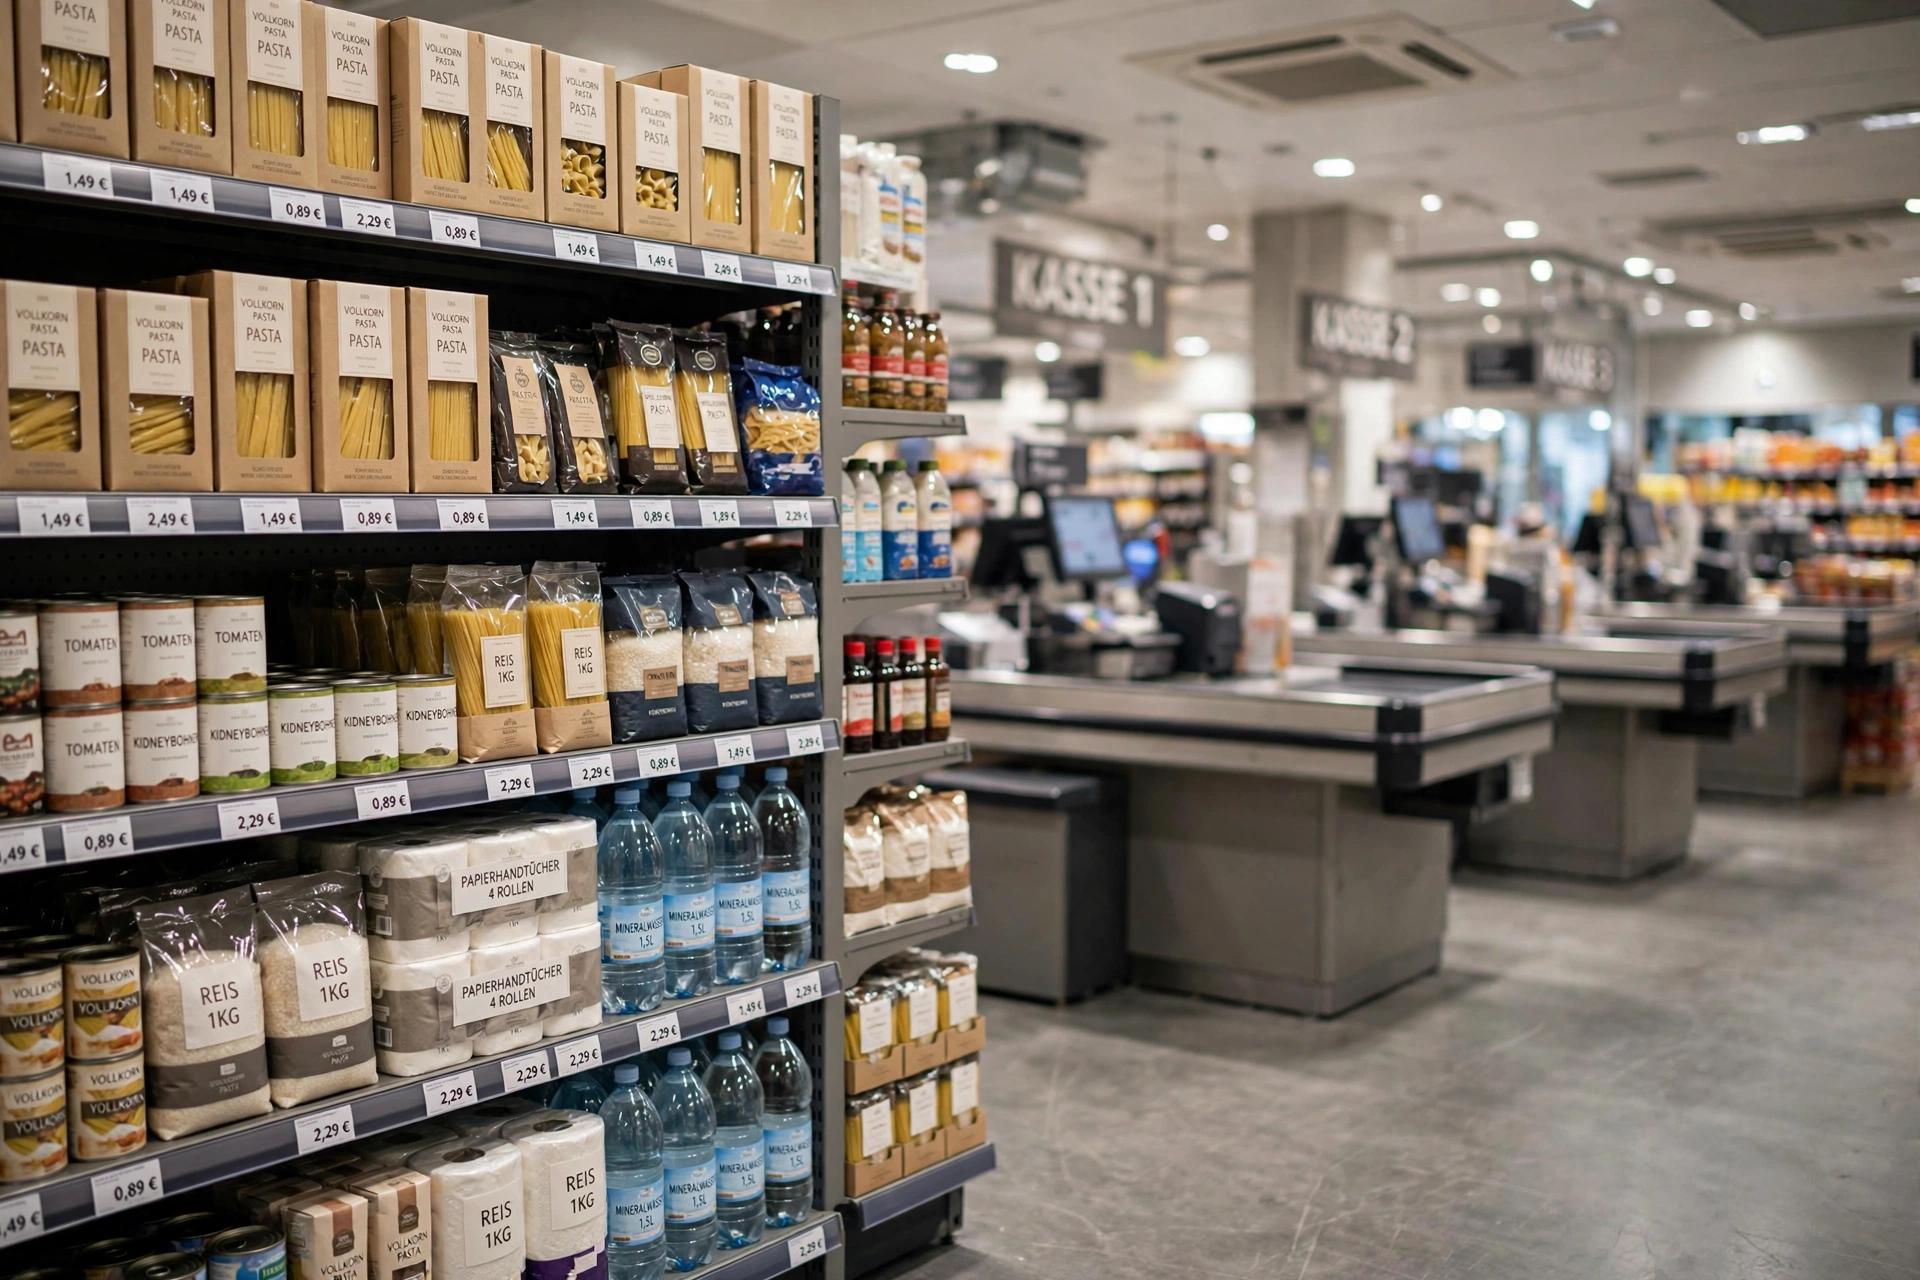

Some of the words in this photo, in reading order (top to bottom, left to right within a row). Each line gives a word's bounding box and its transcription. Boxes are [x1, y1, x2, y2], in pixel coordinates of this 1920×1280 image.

[54, 1, 96, 23] PASTA
[172, 8, 196, 22] PASTA
[252, 11, 294, 28] VOLLKORN
[165, 24, 202, 44] PASTA
[264, 25, 286, 38] PASTA
[331, 31, 370, 46] VOLLKORN
[258, 40, 291, 59] PASTA
[342, 43, 363, 56] PASTA
[425, 42, 462, 59] VOLLKORN
[337, 57, 368, 75] PASTA
[435, 56, 455, 67] PASTA
[430, 70, 460, 86] PASTA
[501, 69, 519, 80] PASTA
[496, 83, 523, 100] PASTA
[569, 102, 597, 119] PASTA
[644, 130, 669, 146] PASTA
[66, 172, 95, 189] 1,49
[99, 177, 108, 190] €
[170, 187, 199, 203] 1,49
[200, 192, 209, 204] €
[286, 203, 310, 218] 0,89
[312, 208, 321, 219] €
[357, 213, 382, 228] 2,29
[383, 218, 391, 229] €
[445, 225, 467, 240] 0,89
[469, 229, 476, 241] €
[568, 244, 588, 256] 1,49
[589, 245, 595, 257] €
[648, 254, 665, 267] 1,49
[667, 257, 674, 268] €
[731, 265, 738, 277] €
[1012, 250, 1126, 321] KASSE
[1134, 274, 1153, 327] 1
[241, 298, 284, 310] VOLLKORN
[344, 306, 384, 318] VOLLKORN
[16, 309, 68, 322] VOLLKORN
[253, 312, 276, 322] PASTA
[355, 319, 376, 328] PASTA
[432, 312, 470, 324] VOLLKORN
[30, 324, 58, 335] PASTA
[136, 318, 183, 330] VOLLKORN
[443, 325, 462, 334] PASTA
[1313, 300, 1389, 359] KASSE
[1394, 316, 1414, 363] 2
[149, 332, 174, 343] PASTA
[247, 328, 281, 343] PASTA
[350, 334, 382, 349] PASTA
[23, 340, 65, 357] PASTA
[437, 339, 467, 354] PASTA
[143, 348, 181, 364] PASTA
[41, 514, 70, 527] 1,49
[74, 514, 84, 526] €
[148, 513, 178, 527] 2,49
[180, 514, 189, 526] €
[260, 513, 285, 527] 1,49
[289, 513, 296, 525] €
[358, 512, 381, 525] 0,89
[385, 513, 392, 524] €
[453, 512, 474, 525] 0,89
[478, 513, 484, 524] €
[566, 512, 586, 524] 1,49
[588, 512, 594, 523] €
[644, 512, 663, 522] 0,89
[665, 512, 670, 521] €
[142, 634, 192, 647] TOMATEN
[216, 630, 263, 643] TOMATEN
[65, 638, 117, 652] TOMATEN
[574, 647, 593, 659] REIS
[495, 654, 514, 667] REIS
[577, 663, 593, 674] 1KG
[498, 671, 515, 683] 1KG
[66, 741, 119, 756] TOMATEN
[745, 747, 750, 756] €
[650, 759, 668, 769] 0,89
[670, 757, 676, 766] €
[583, 768, 602, 779] 2,29
[604, 767, 610, 776] €
[501, 780, 521, 792] 2,29
[523, 778, 530, 789] €
[372, 797, 396, 811] 0,89
[399, 795, 406, 806] €
[238, 815, 264, 830] 2,29
[268, 813, 275, 825] €
[85, 834, 114, 851] 0,89
[120, 833, 128, 845] €
[0, 846, 25, 863] ,49
[31, 845, 40, 857] €
[461, 859, 560, 888] PAPIERHANDTÜCHER
[489, 889, 494, 899] 4
[497, 880, 534, 898] ROLLEN
[313, 958, 347, 979] REIS
[462, 964, 562, 998] PAPIERHANDTÜCHER
[200, 981, 239, 1006] REIS
[320, 982, 349, 1003] 1KG
[490, 997, 496, 1008] 4
[498, 989, 535, 1007] ROLLEN
[208, 1007, 240, 1030] 1KG
[651, 1027, 670, 1041] 2,29
[672, 1025, 677, 1035] €
[570, 1051, 590, 1066] 2,29
[591, 1048, 597, 1059] €
[517, 1066, 537, 1082] 2,29
[540, 1064, 546, 1074] €
[441, 1088, 464, 1104] 2,29
[466, 1085, 472, 1097] €
[313, 1124, 339, 1143] 2,29
[342, 1121, 350, 1132] €
[567, 1168, 595, 1192] REIS
[114, 1180, 144, 1201] 0,89
[148, 1177, 157, 1190] €
[570, 1193, 595, 1214] 1KG
[0, 1215, 27, 1233] ,49
[31, 1211, 40, 1226] €
[481, 1201, 512, 1227] REIS
[485, 1227, 512, 1248] 1KG
